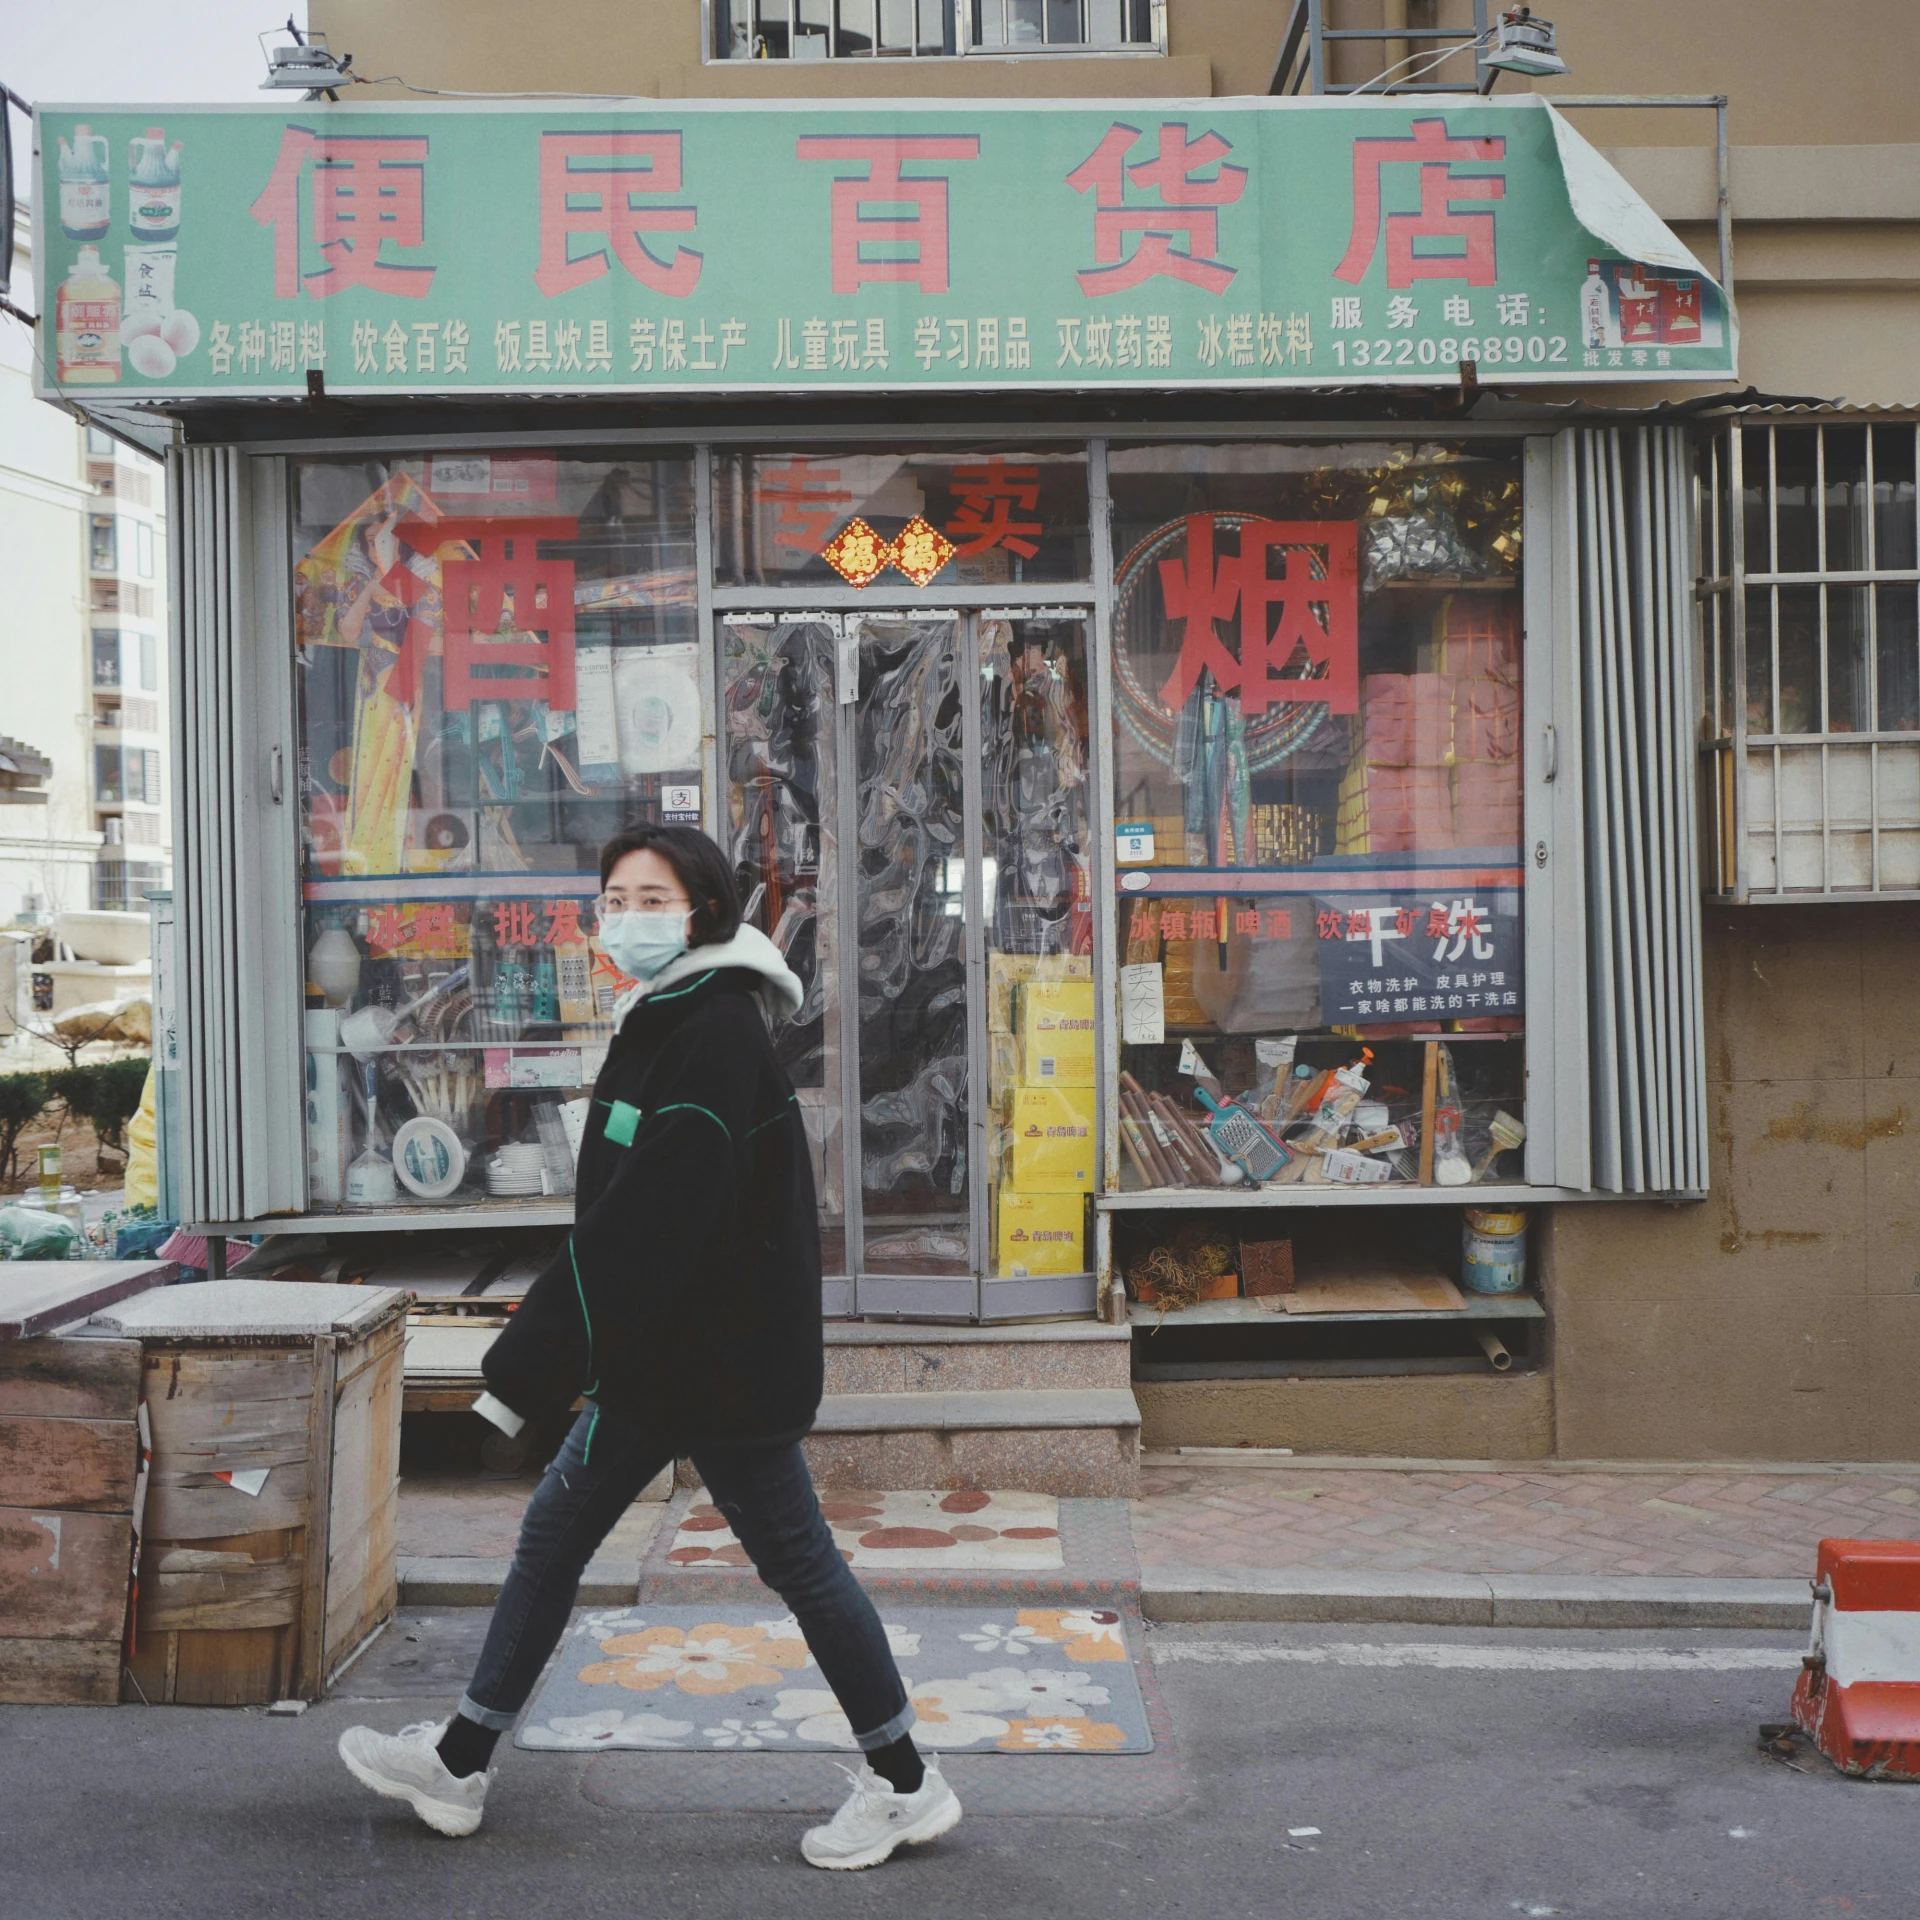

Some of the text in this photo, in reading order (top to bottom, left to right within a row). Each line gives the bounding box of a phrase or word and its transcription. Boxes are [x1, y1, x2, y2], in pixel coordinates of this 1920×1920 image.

[249, 117, 1506, 299] 便民百货店
[209, 312, 1314, 375] 各种调料 饮食百货 饭具炊具 劳保土产 儿童玩具 学习用品 灭蚊药器 冰糕饮料
[1332, 336, 1568, 367] 13220868902
[1583, 350, 1672, 367] 批发零售
[753, 455, 1042, 560] 专卖
[840, 534, 877, 573] 福
[900, 532, 938, 571] 福
[379, 509, 579, 711] 酒
[1158, 514, 1359, 714] 烟
[664, 812, 699, 821] 支付宝付款
[365, 901, 585, 949] 冰糕 批发
[1130, 908, 1482, 941] 冰镇瓶 啤酒 饮料 矿泉水
[1346, 898, 1494, 967] 干洗
[1128, 965, 1160, 1039] 卖大米
[1340, 991, 1517, 1015] 一家啥都能洗的干洗店
[1350, 972, 1506, 995] 衣物洗护 皮具护理
